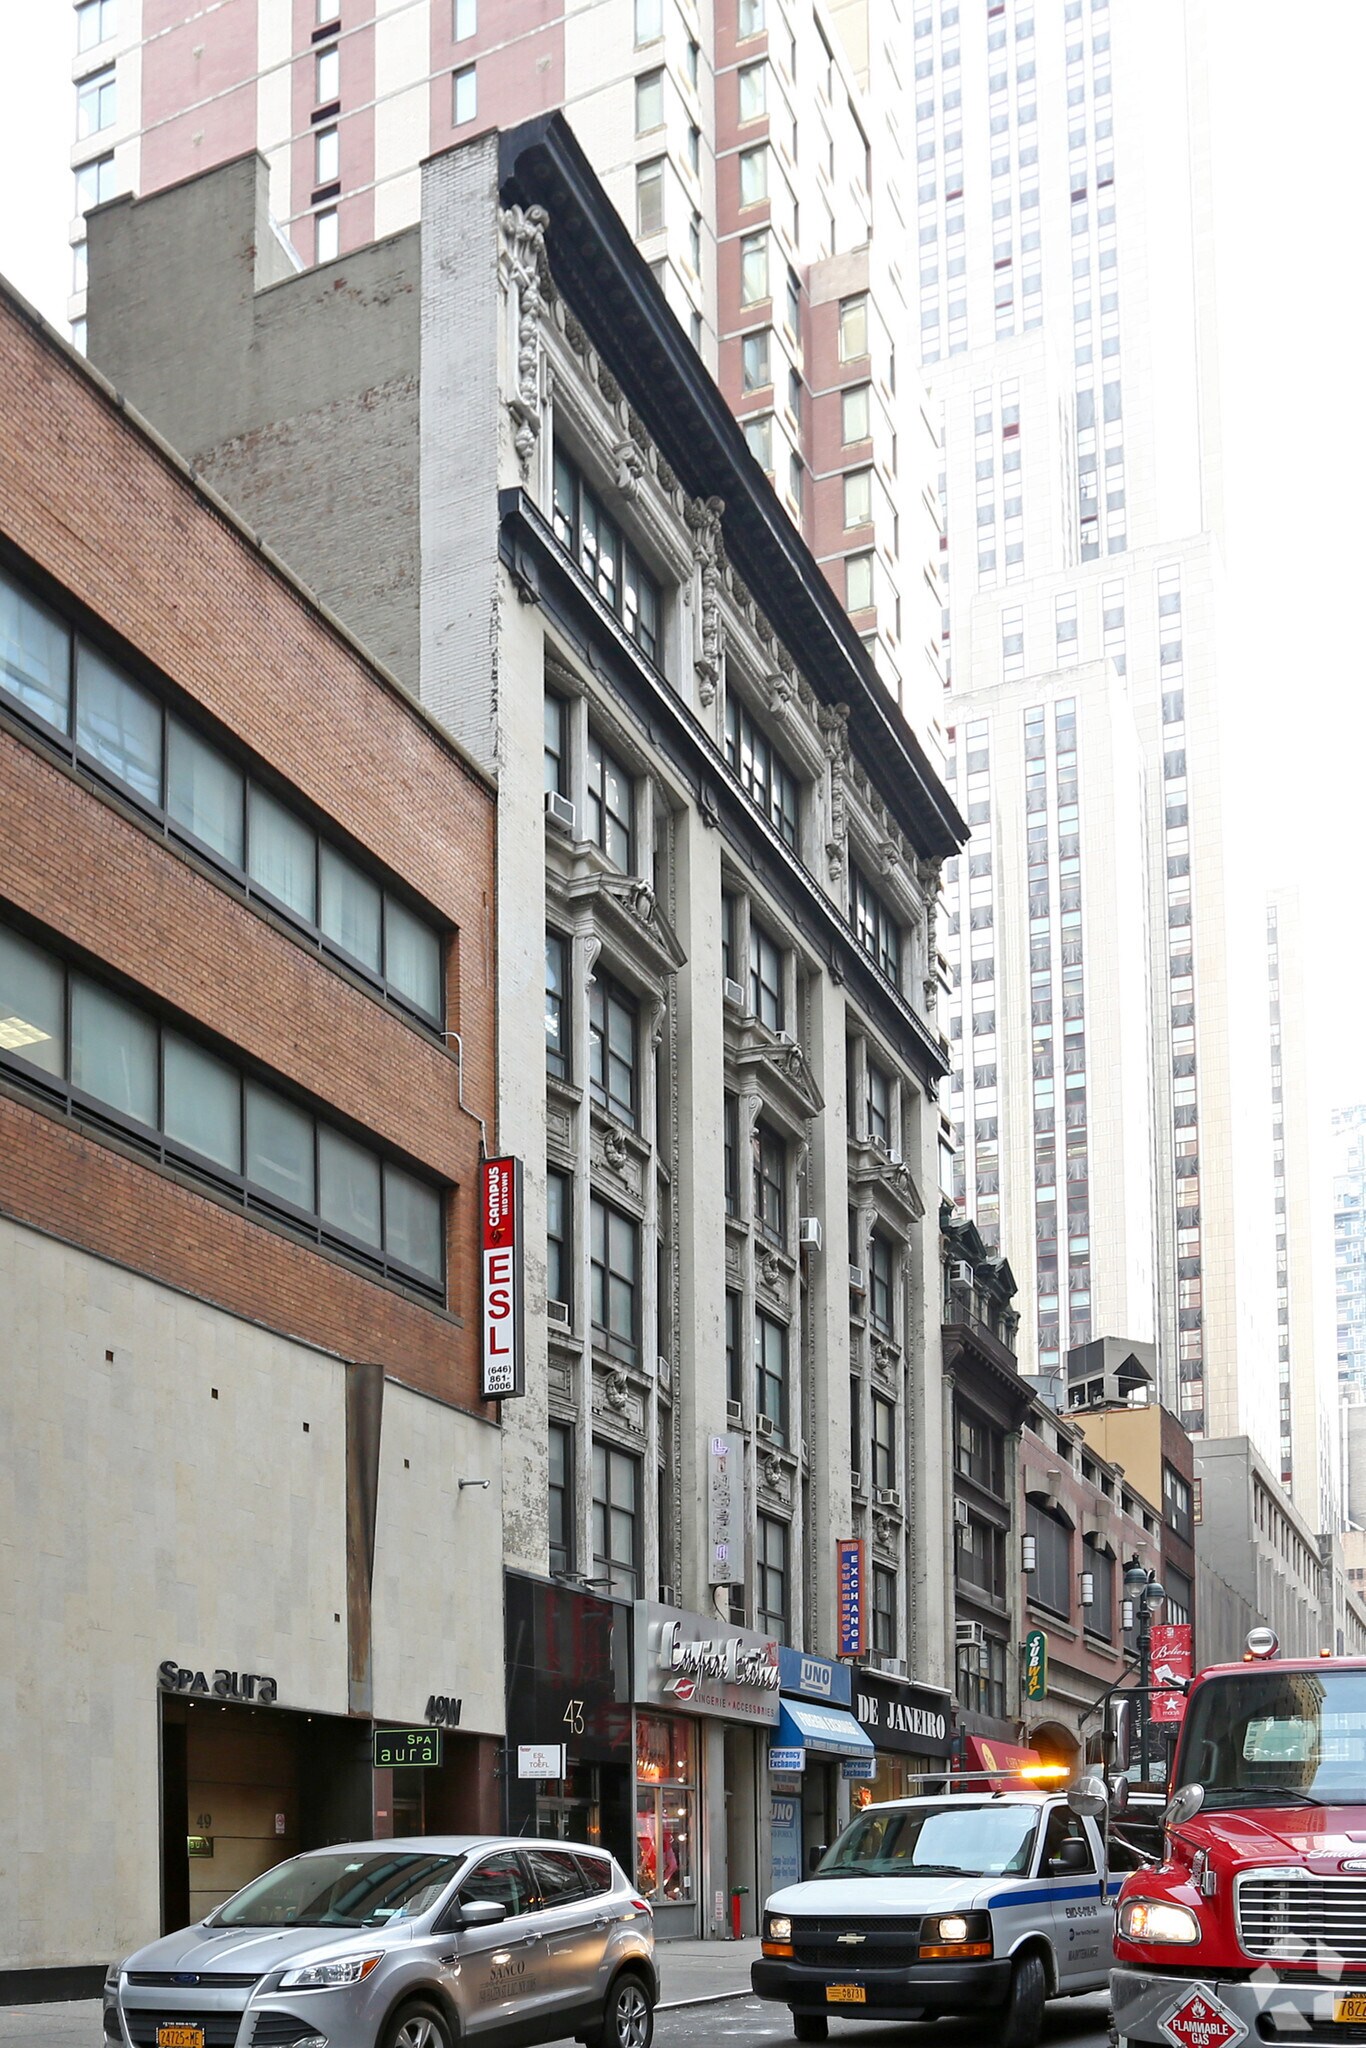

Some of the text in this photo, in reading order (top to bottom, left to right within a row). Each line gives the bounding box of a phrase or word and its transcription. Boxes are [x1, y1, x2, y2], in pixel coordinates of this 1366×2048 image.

[488, 1166, 500, 1227] CAMPUS
[501, 1172, 509, 1216] MIDTOWN
[488, 1254, 511, 1356] ESL
[488, 1366, 512, 1376] (646)
[489, 1375, 510, 1383] 861-
[488, 1382, 511, 1391] 0006
[842, 1562, 851, 1642] CURRENCY
[850, 1555, 859, 1650] EXCHANGE
[1151, 1643, 1191, 1660] Believe
[804, 1663, 830, 1685] UNO
[1028, 1636, 1041, 1696] SUBWAY
[213, 1669, 278, 1701] aura
[424, 1694, 462, 1726] 49W
[694, 1693, 775, 1718] LINGERIE ACCESSORIES
[563, 1699, 585, 1734] 43
[857, 1693, 946, 1740] DE JANEIRO
[381, 1748, 432, 1762] aura
[770, 1750, 800, 1760] Currency
[770, 1759, 801, 1769] Exchange
[843, 1761, 871, 1770] Currency
[843, 1769, 872, 1778] Exchange
[490, 1961, 526, 1980] SANCO
[1172, 2019, 1229, 2036] FLAMMABLE
[1191, 2032, 1210, 2046] GAS
